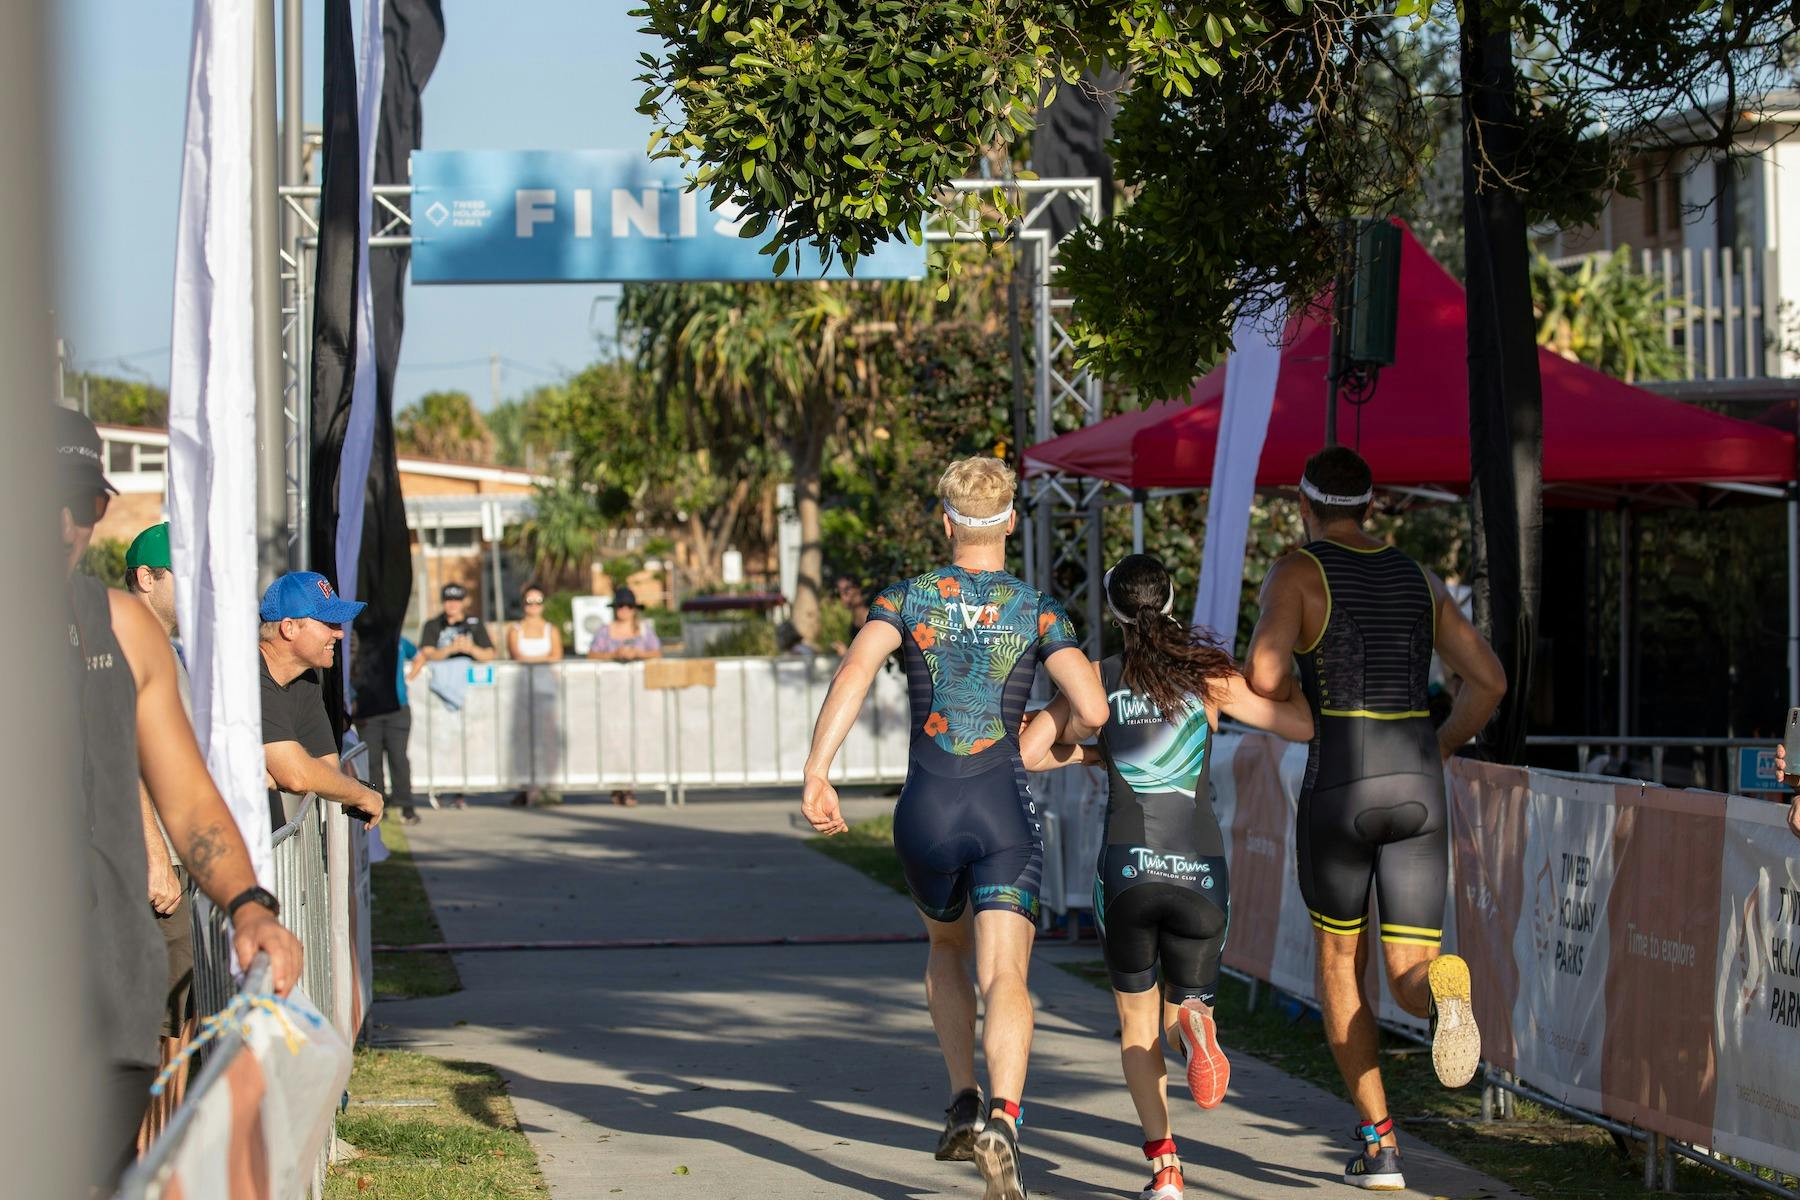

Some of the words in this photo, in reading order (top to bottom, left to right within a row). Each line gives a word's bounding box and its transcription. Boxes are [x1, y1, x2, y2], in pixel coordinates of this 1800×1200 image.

[515, 188, 800, 238] FINIS
[939, 632, 1001, 645] VOLARE
[1316, 645, 1331, 706] VOLARE
[1108, 689, 1149, 725] Twin
[1129, 847, 1168, 871] Twin
[1164, 854, 1211, 874] Towns
[1147, 869, 1179, 879] TRIATHLON
[1561, 853, 1592, 887] TWEED
[1559, 897, 1597, 934] HOLIDAY
[1555, 940, 1584, 976] PARKS
[1627, 922, 1648, 957] Time
[1650, 931, 1660, 960] to
[1661, 931, 1696, 974] explore
